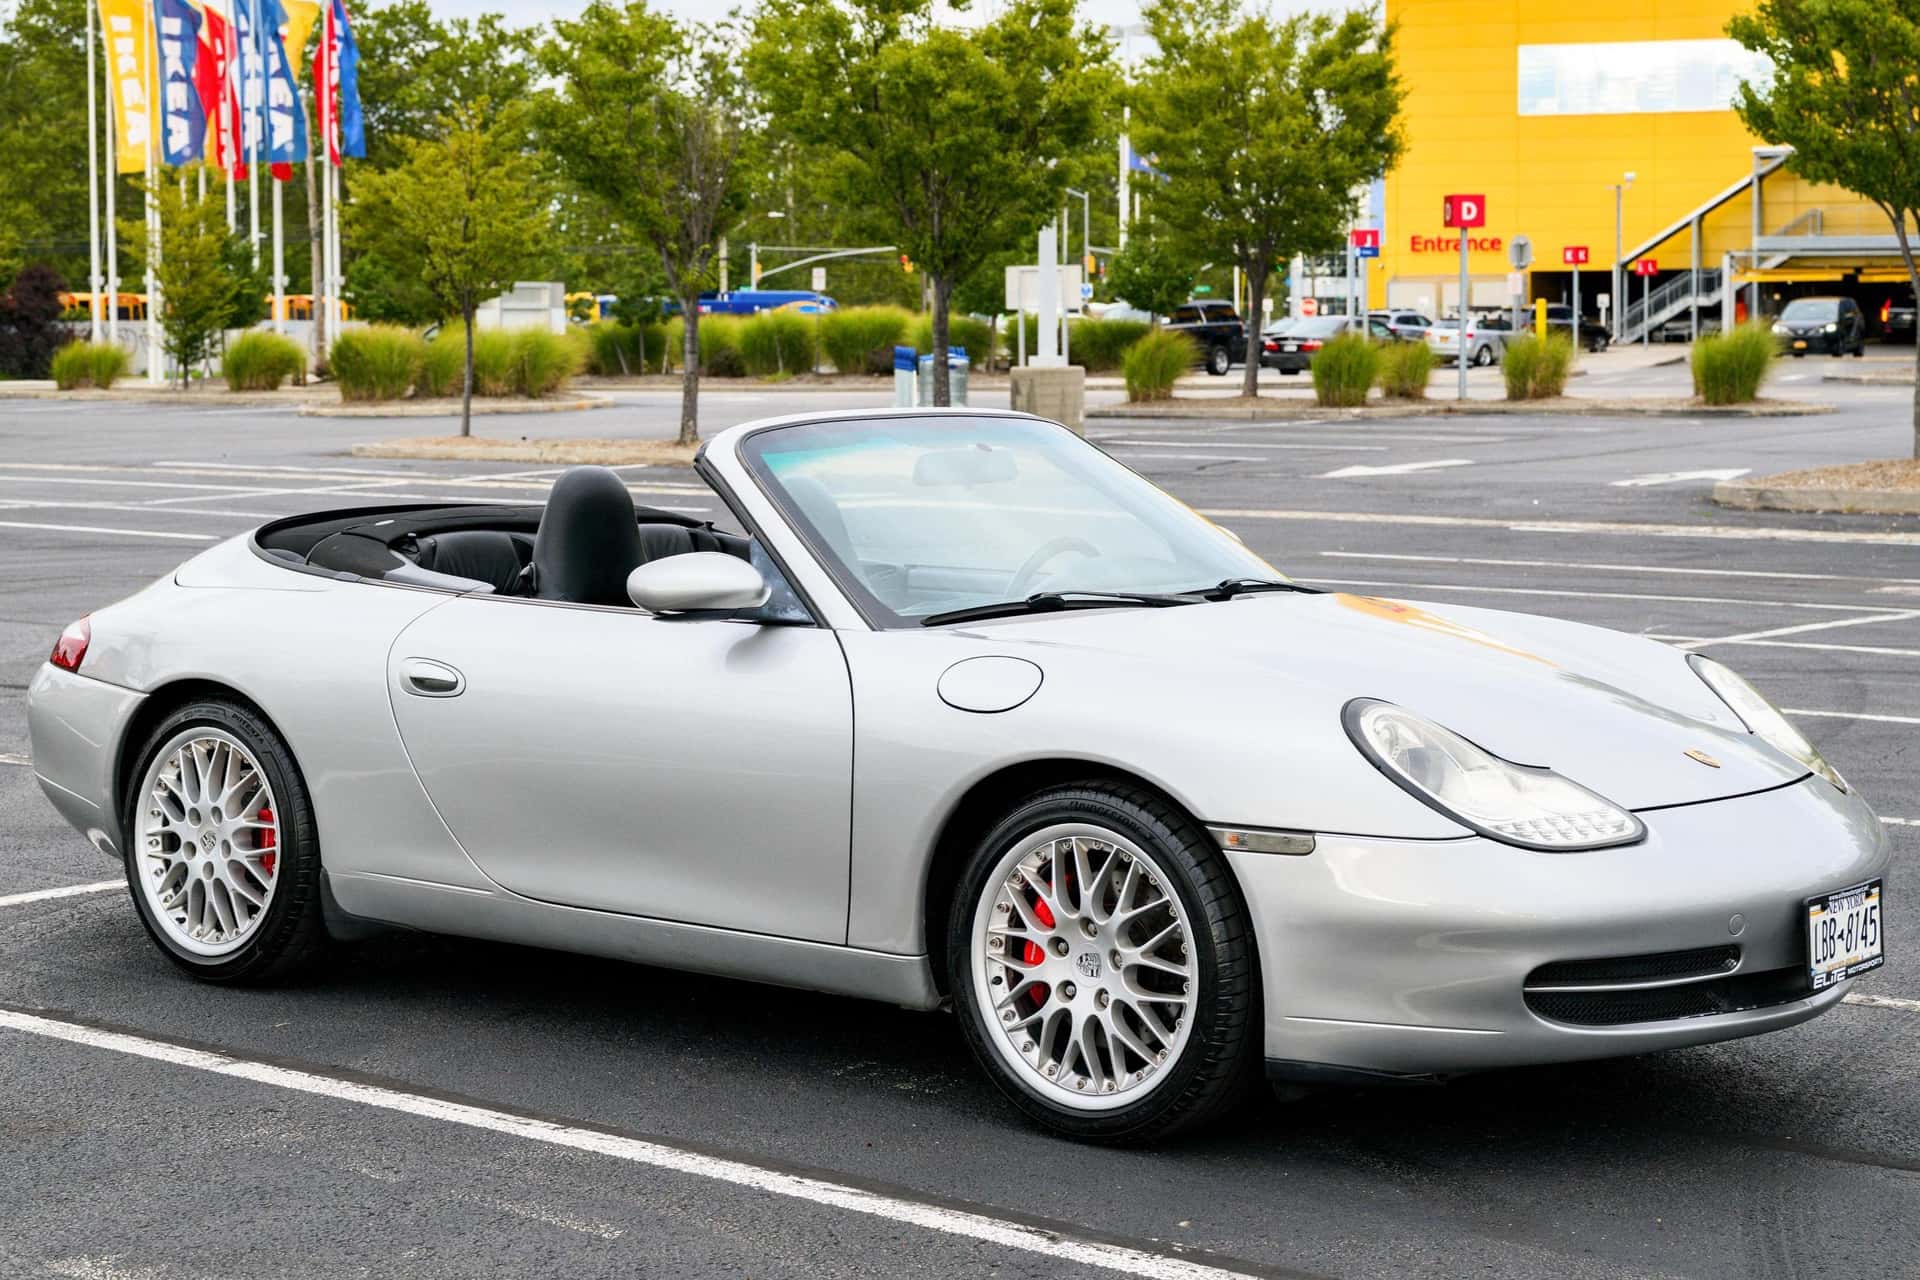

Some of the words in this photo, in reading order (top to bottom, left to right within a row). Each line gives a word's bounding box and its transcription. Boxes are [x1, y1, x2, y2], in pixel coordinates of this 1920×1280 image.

[110, 16, 146, 146] IKEA
[161, 17, 190, 155] IKEA
[1410, 235, 1502, 252] Entrance
[1461, 201, 1477, 221] D
